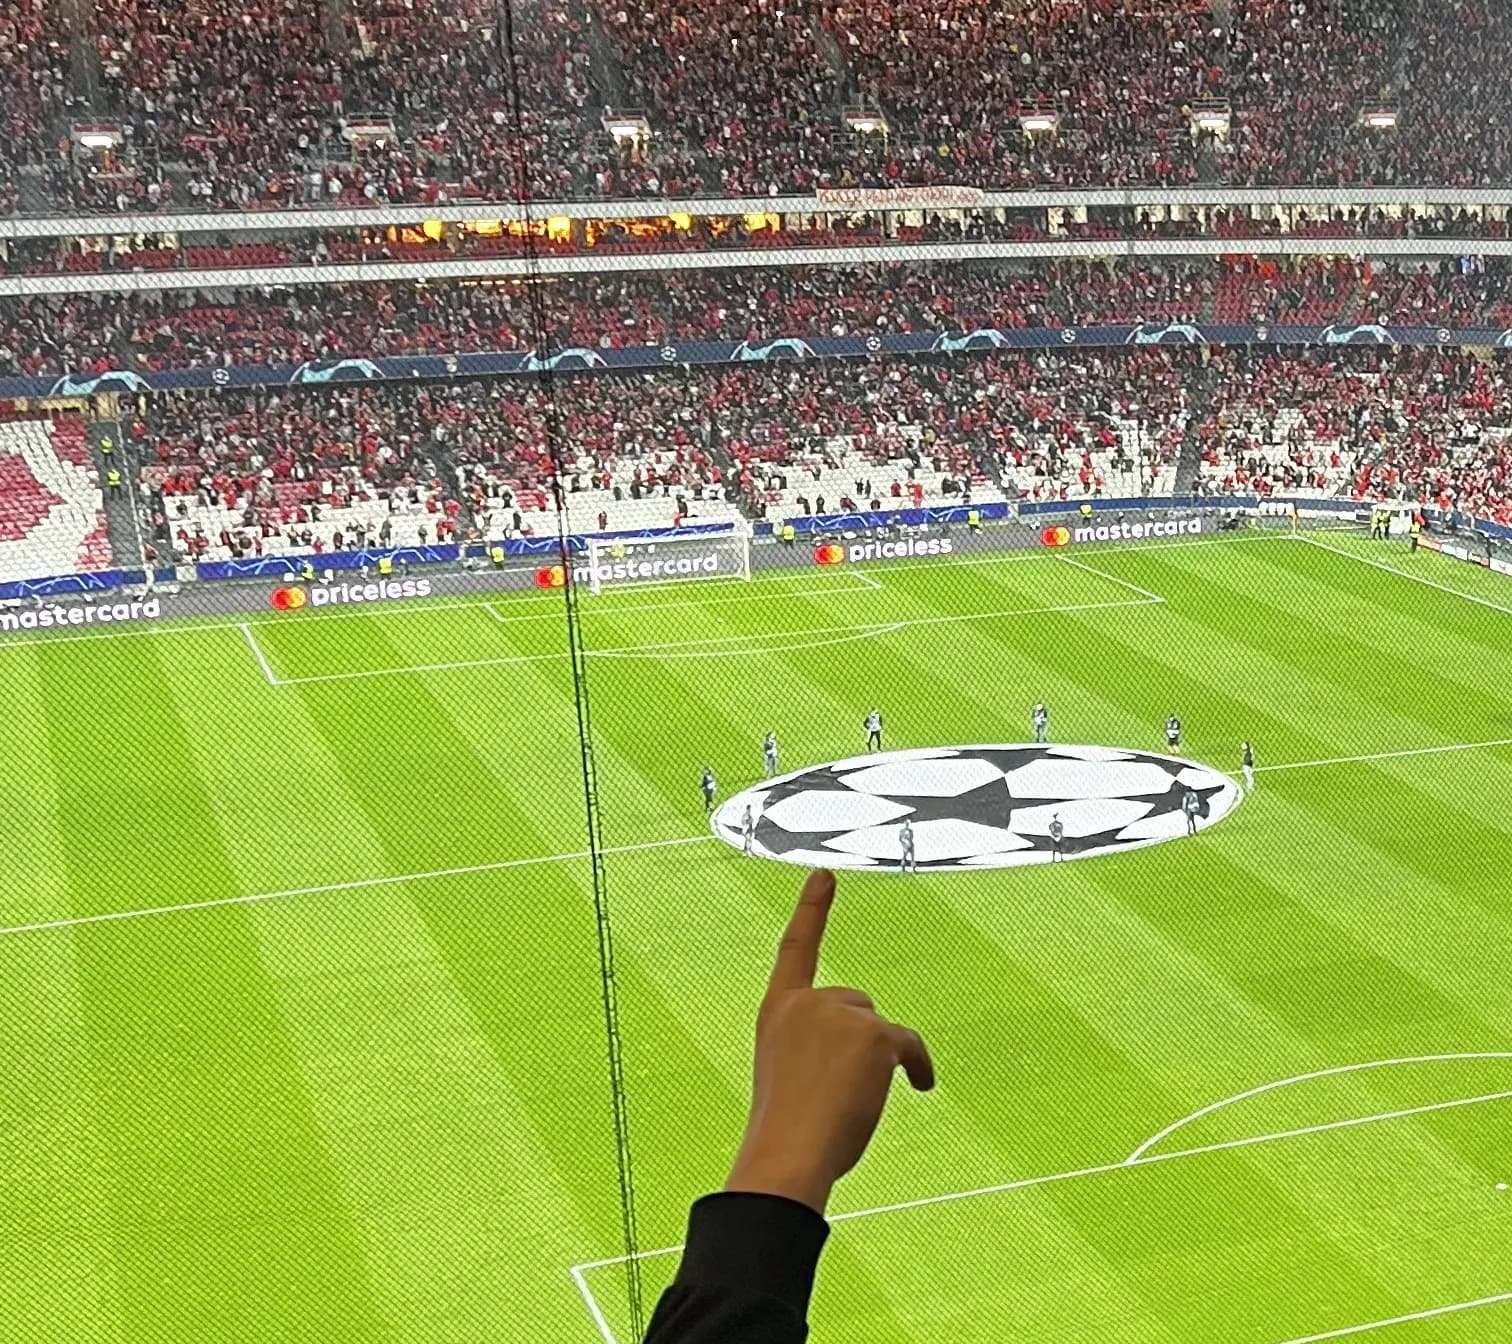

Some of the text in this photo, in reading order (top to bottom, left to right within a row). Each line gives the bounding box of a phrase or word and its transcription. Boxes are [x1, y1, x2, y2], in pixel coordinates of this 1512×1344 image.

[1074, 517, 1202, 543] mastercard
[849, 537, 953, 563] priceless
[573, 552, 718, 583] mastercard
[311, 578, 432, 607] priceless
